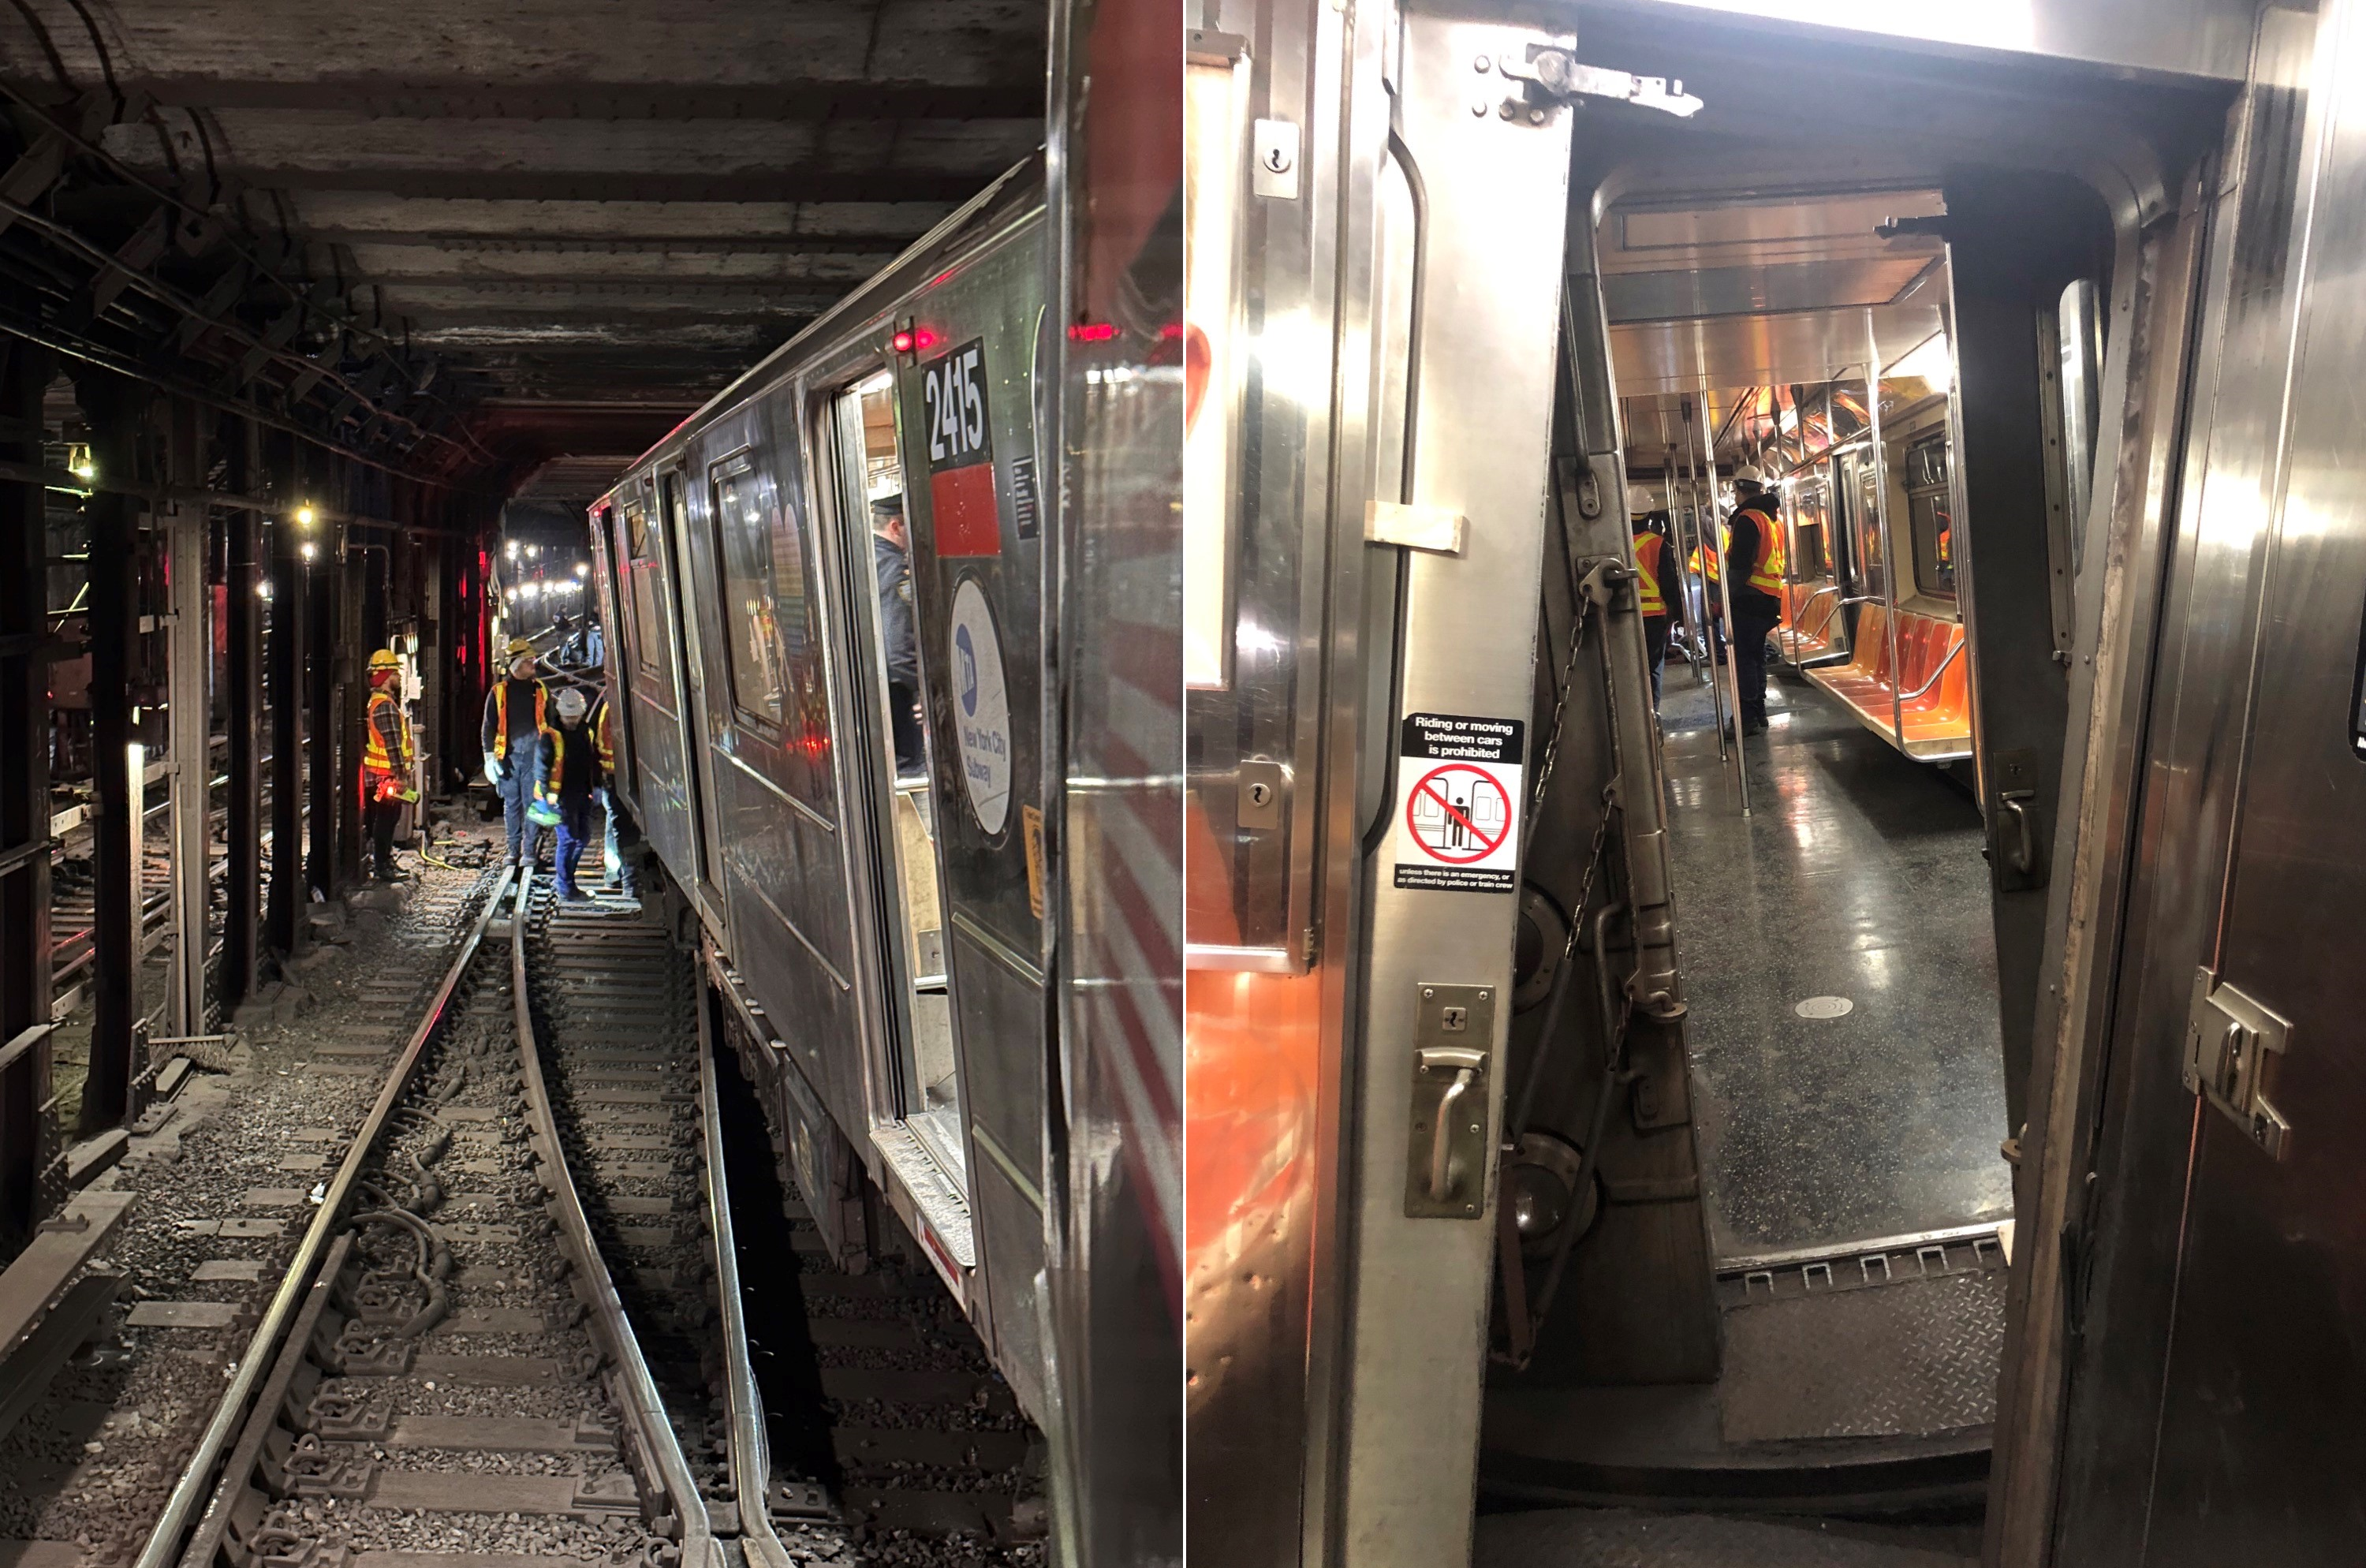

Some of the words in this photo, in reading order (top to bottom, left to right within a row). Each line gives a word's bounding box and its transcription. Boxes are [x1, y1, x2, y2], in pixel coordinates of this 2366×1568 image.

[926, 349, 983, 461] 2415
[1415, 716, 1453, 731] Riding
[1470, 722, 1513, 735] moving
[964, 726, 977, 749] New
[976, 727, 992, 752] York
[992, 730, 1006, 762] City
[1424, 730, 1475, 744] between
[1477, 736, 1503, 745] cars
[1428, 745, 1439, 754] is
[1441, 746, 1500, 759] prohibited
[967, 755, 991, 788] Subway
[1461, 872, 1501, 880] emergency,
